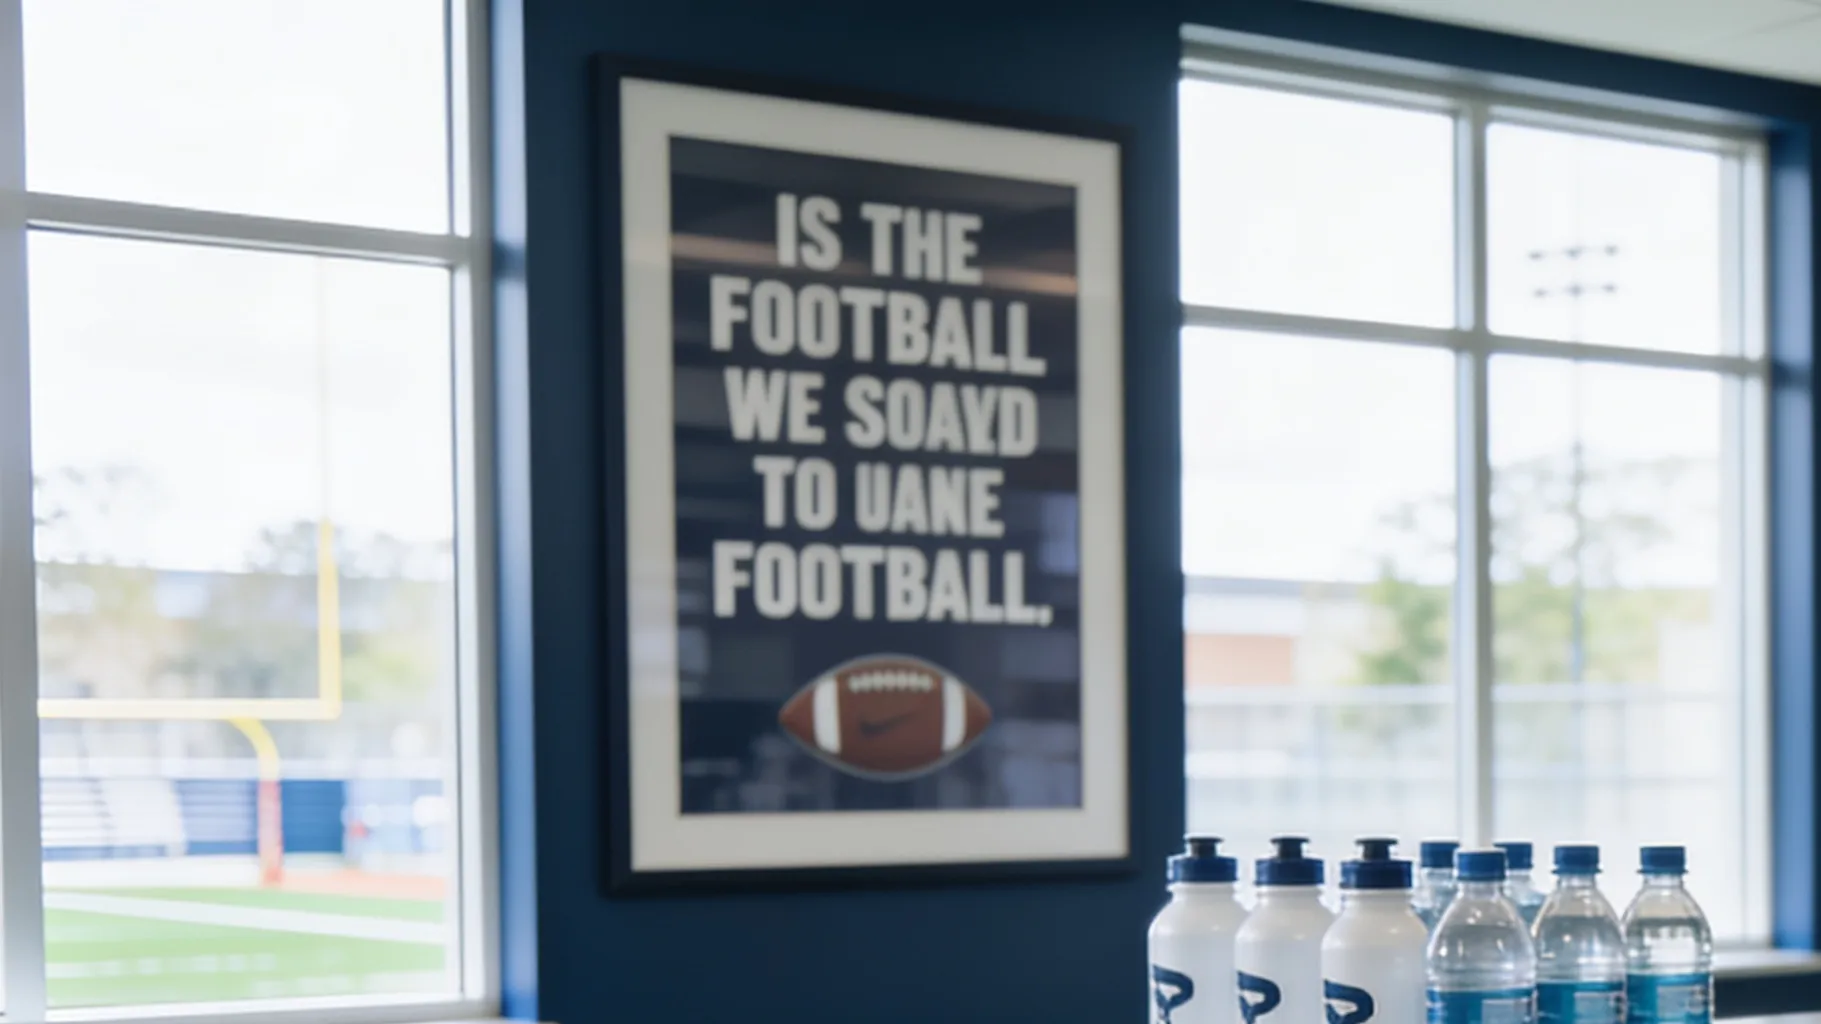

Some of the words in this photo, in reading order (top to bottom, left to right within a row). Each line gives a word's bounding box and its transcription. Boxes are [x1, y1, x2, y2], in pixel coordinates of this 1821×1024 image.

[777, 194, 842, 271] IS
[861, 202, 983, 286] THE
[710, 275, 1047, 376] FOOTBALL
[725, 367, 825, 445] WE
[843, 375, 1037, 457] SOAYD
[753, 456, 838, 531] TO
[855, 461, 1004, 538] UANE
